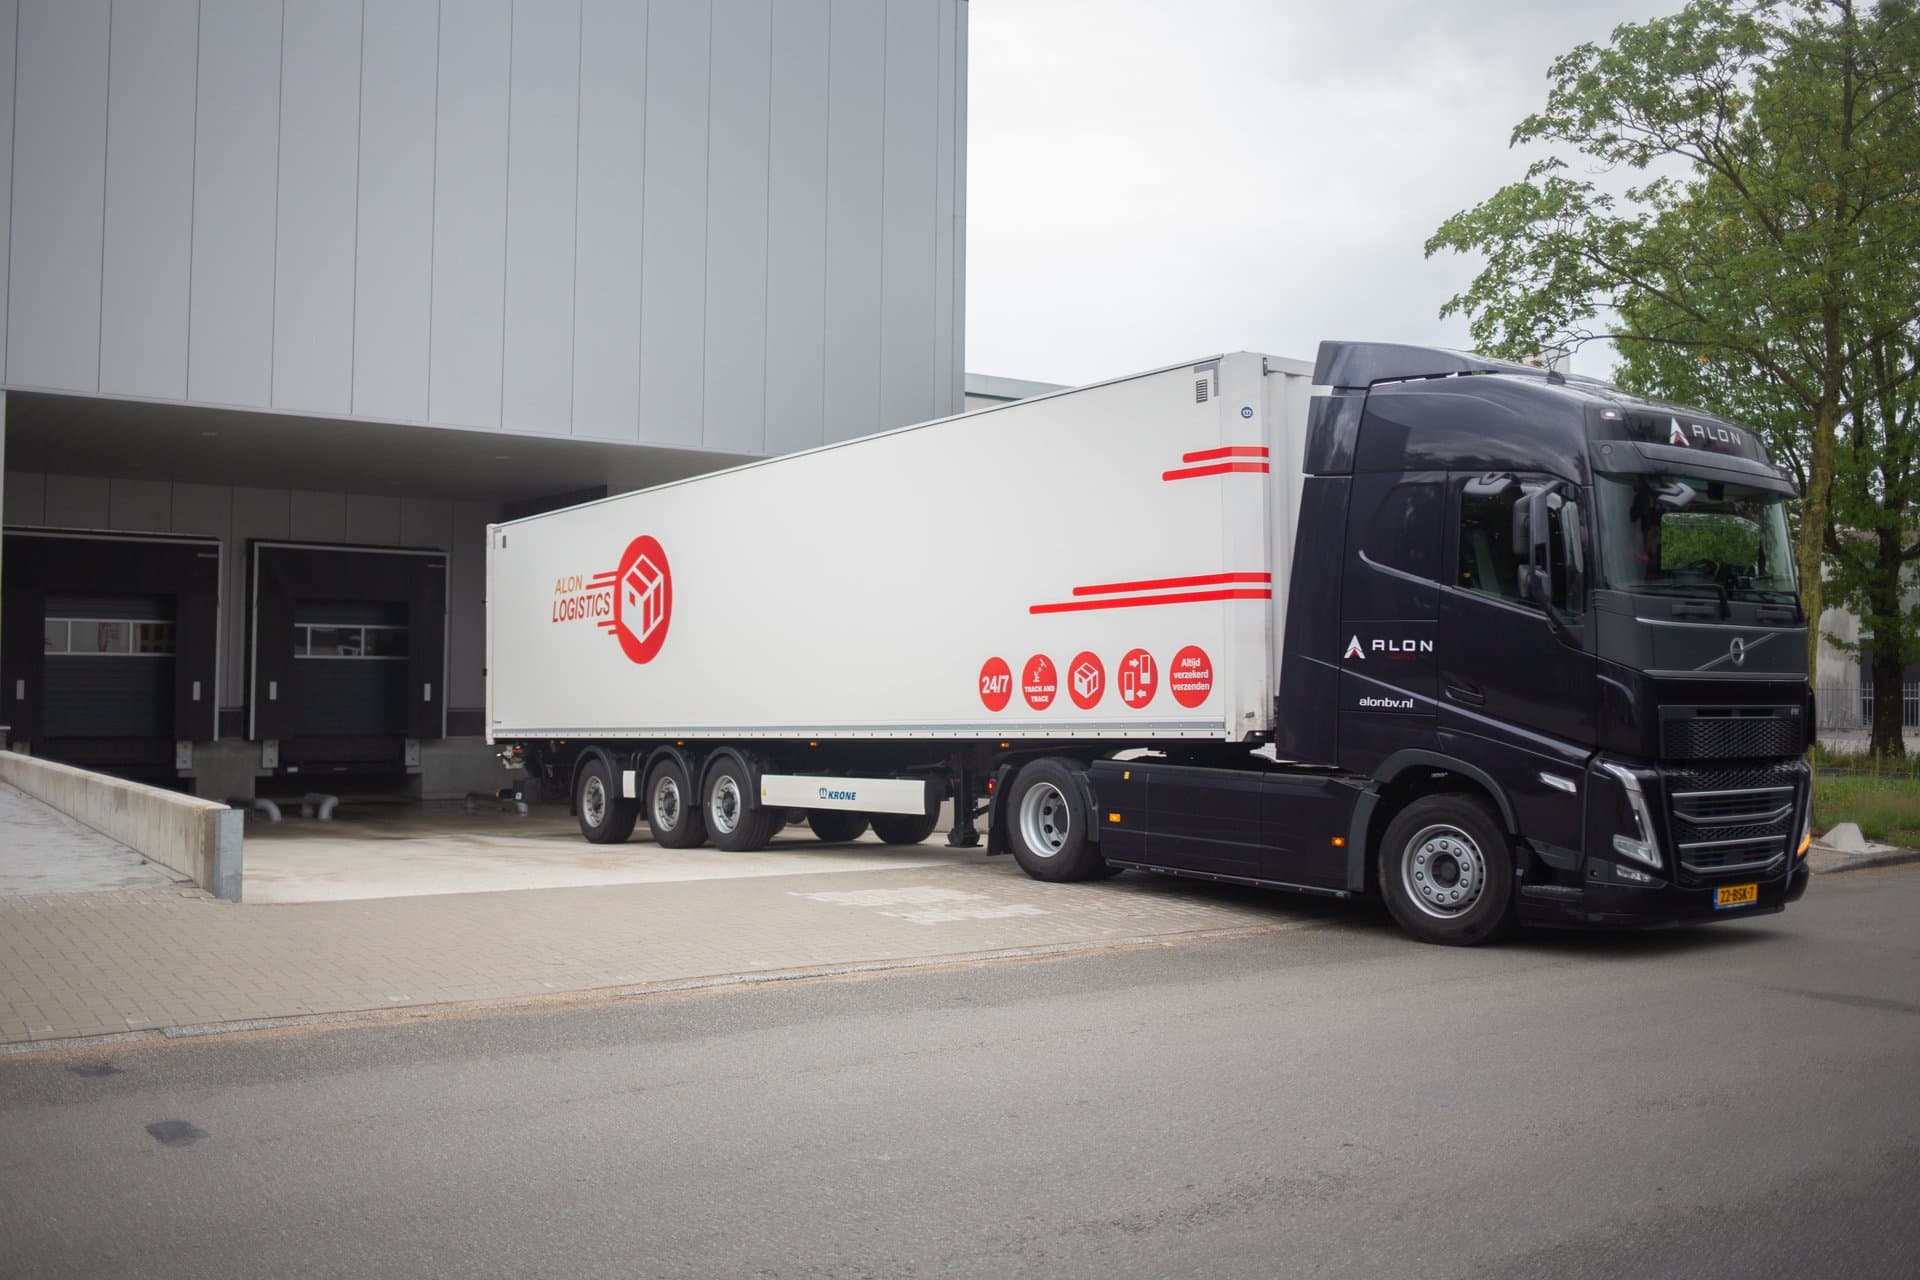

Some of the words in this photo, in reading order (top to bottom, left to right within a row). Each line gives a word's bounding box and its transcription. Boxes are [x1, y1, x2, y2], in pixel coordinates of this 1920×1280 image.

[1691, 424, 1742, 446] ALON
[555, 575, 582, 594] ALON
[552, 591, 610, 622] LOGISTICS
[1372, 639, 1433, 652] ALON
[1181, 657, 1201, 669] Altijd
[981, 674, 1010, 694] 24/7
[1172, 682, 1210, 691] verzenden
[1031, 695, 1049, 703] TRACE
[1359, 696, 1414, 709] alonbv.nl
[828, 791, 857, 801] KRONE
